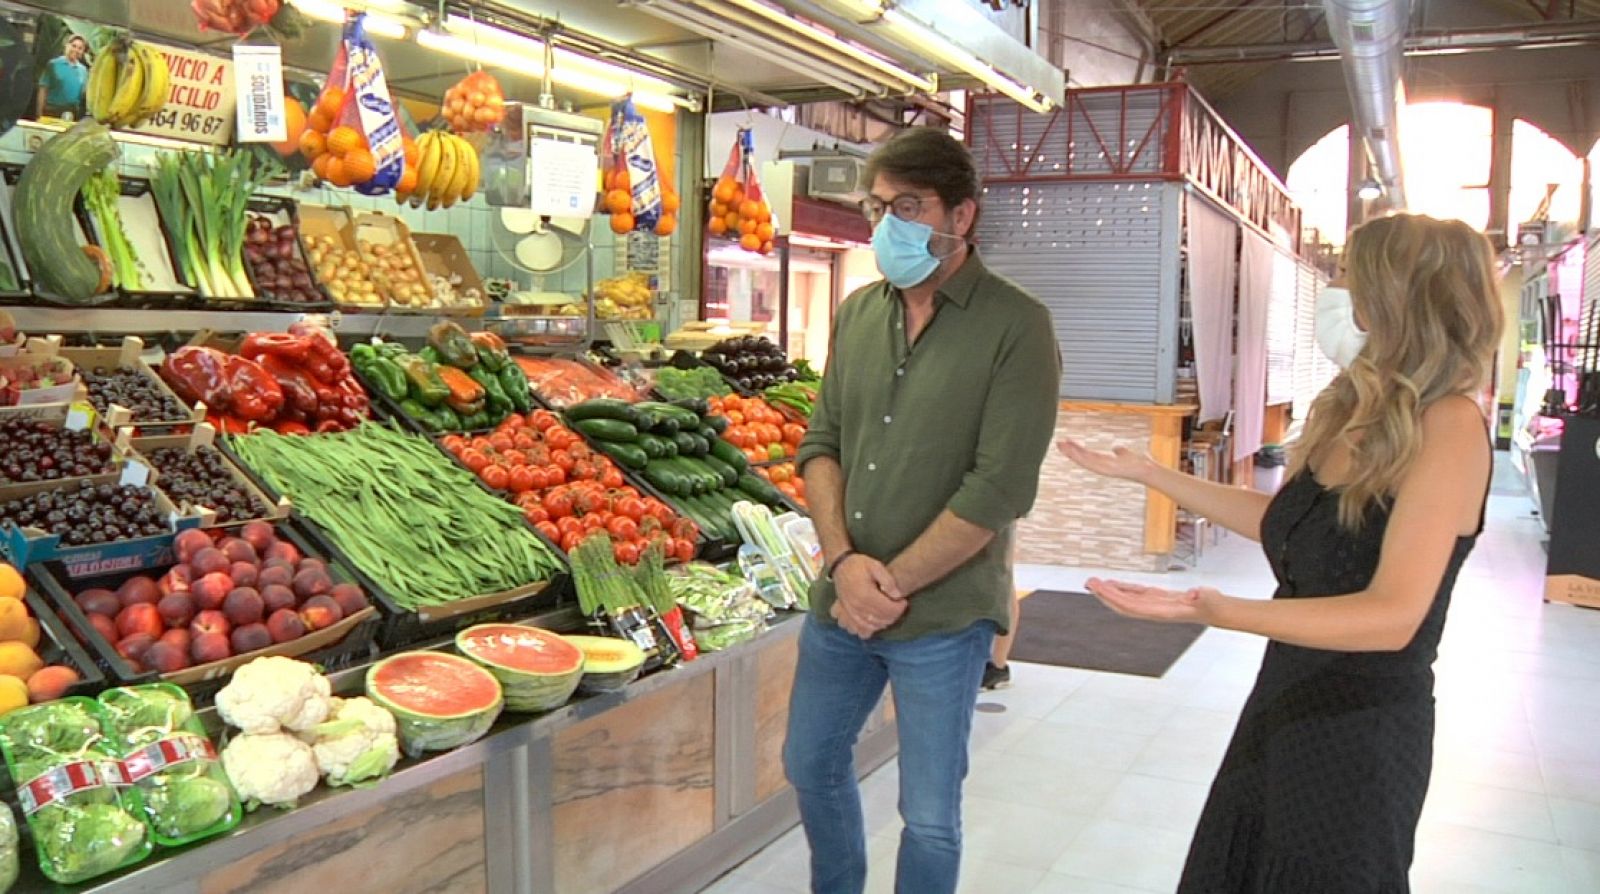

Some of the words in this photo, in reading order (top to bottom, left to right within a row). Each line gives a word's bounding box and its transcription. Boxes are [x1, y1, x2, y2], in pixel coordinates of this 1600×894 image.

[210, 64, 225, 86] A
[168, 84, 221, 111] ICILIO
[180, 112, 202, 132] 96
[202, 115, 225, 135] 87
